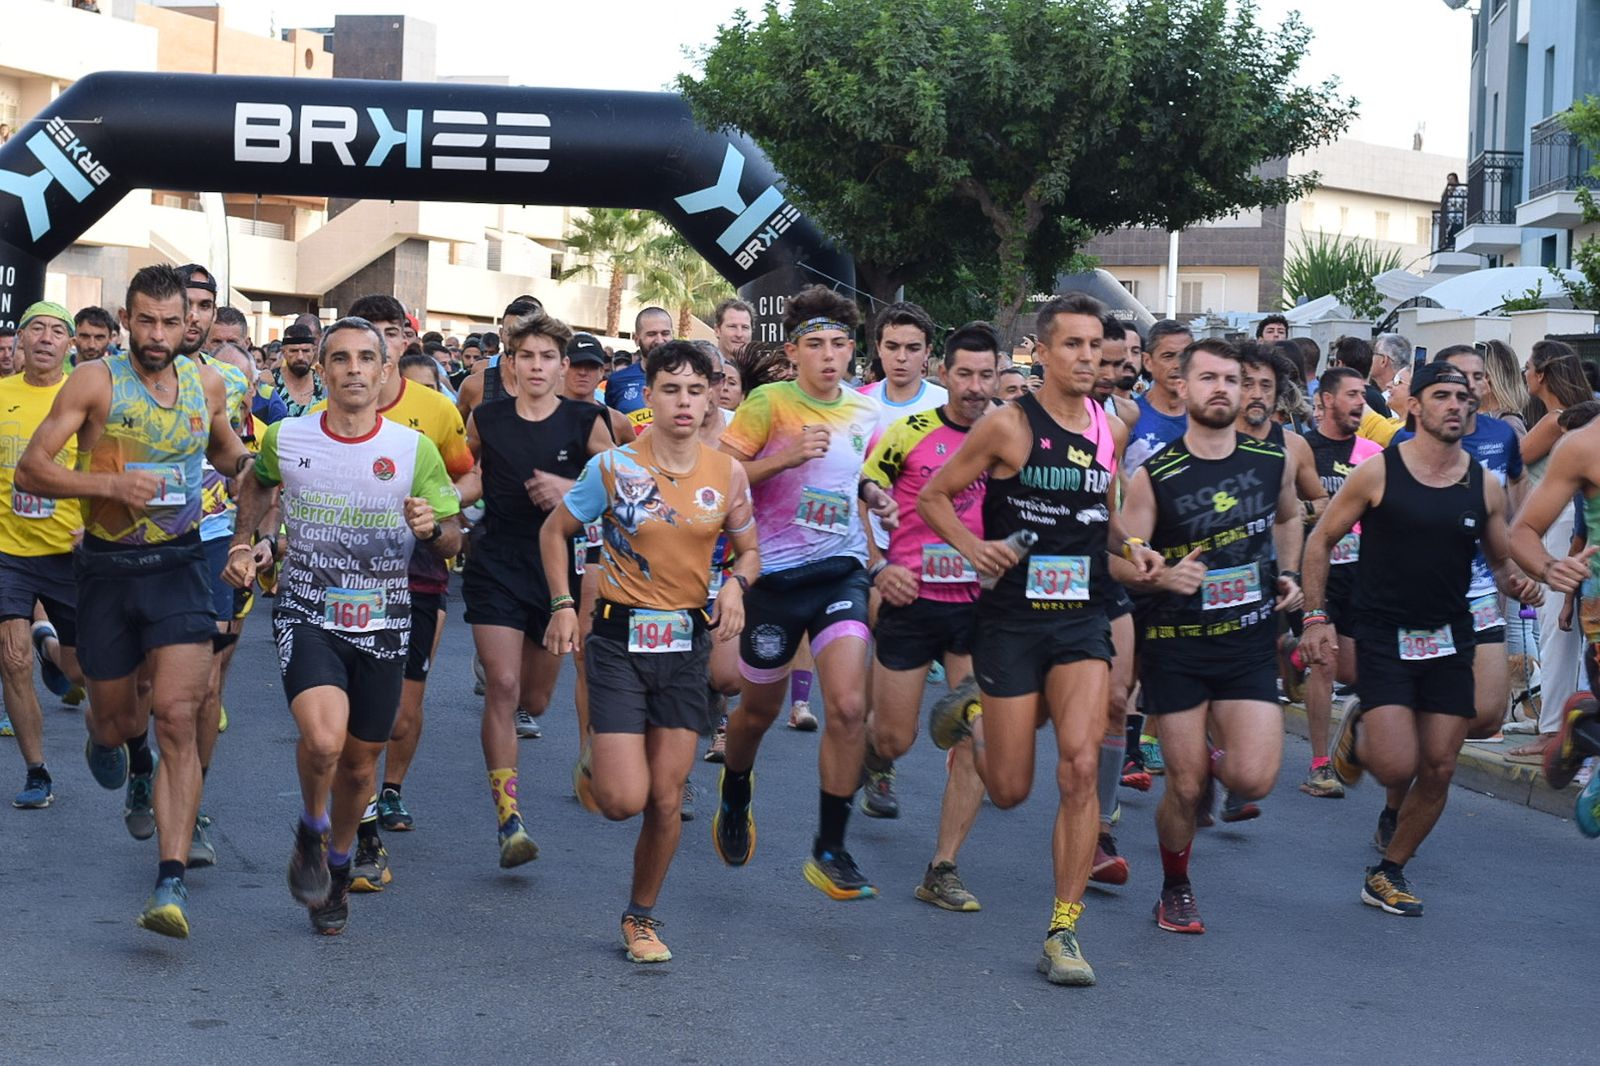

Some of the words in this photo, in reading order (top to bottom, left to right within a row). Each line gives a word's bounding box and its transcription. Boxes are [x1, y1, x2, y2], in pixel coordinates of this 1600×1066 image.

[759, 295, 792, 316] CIC
[760, 323, 789, 343] TRI
[1020, 466, 1081, 492] MALDITO
[1175, 468, 1264, 515] ROCK
[300, 490, 322, 504] Club
[323, 493, 347, 507] Trail
[1212, 491, 1239, 513] &
[288, 498, 336, 526] Sierra
[337, 504, 401, 529] Abuela
[805, 500, 838, 529] 141
[300, 522, 369, 550] Castillejos
[309, 551, 361, 571] Abuela
[926, 556, 964, 578] 408
[1034, 567, 1073, 595] 137
[331, 600, 371, 629] 160
[634, 622, 673, 649] 194
